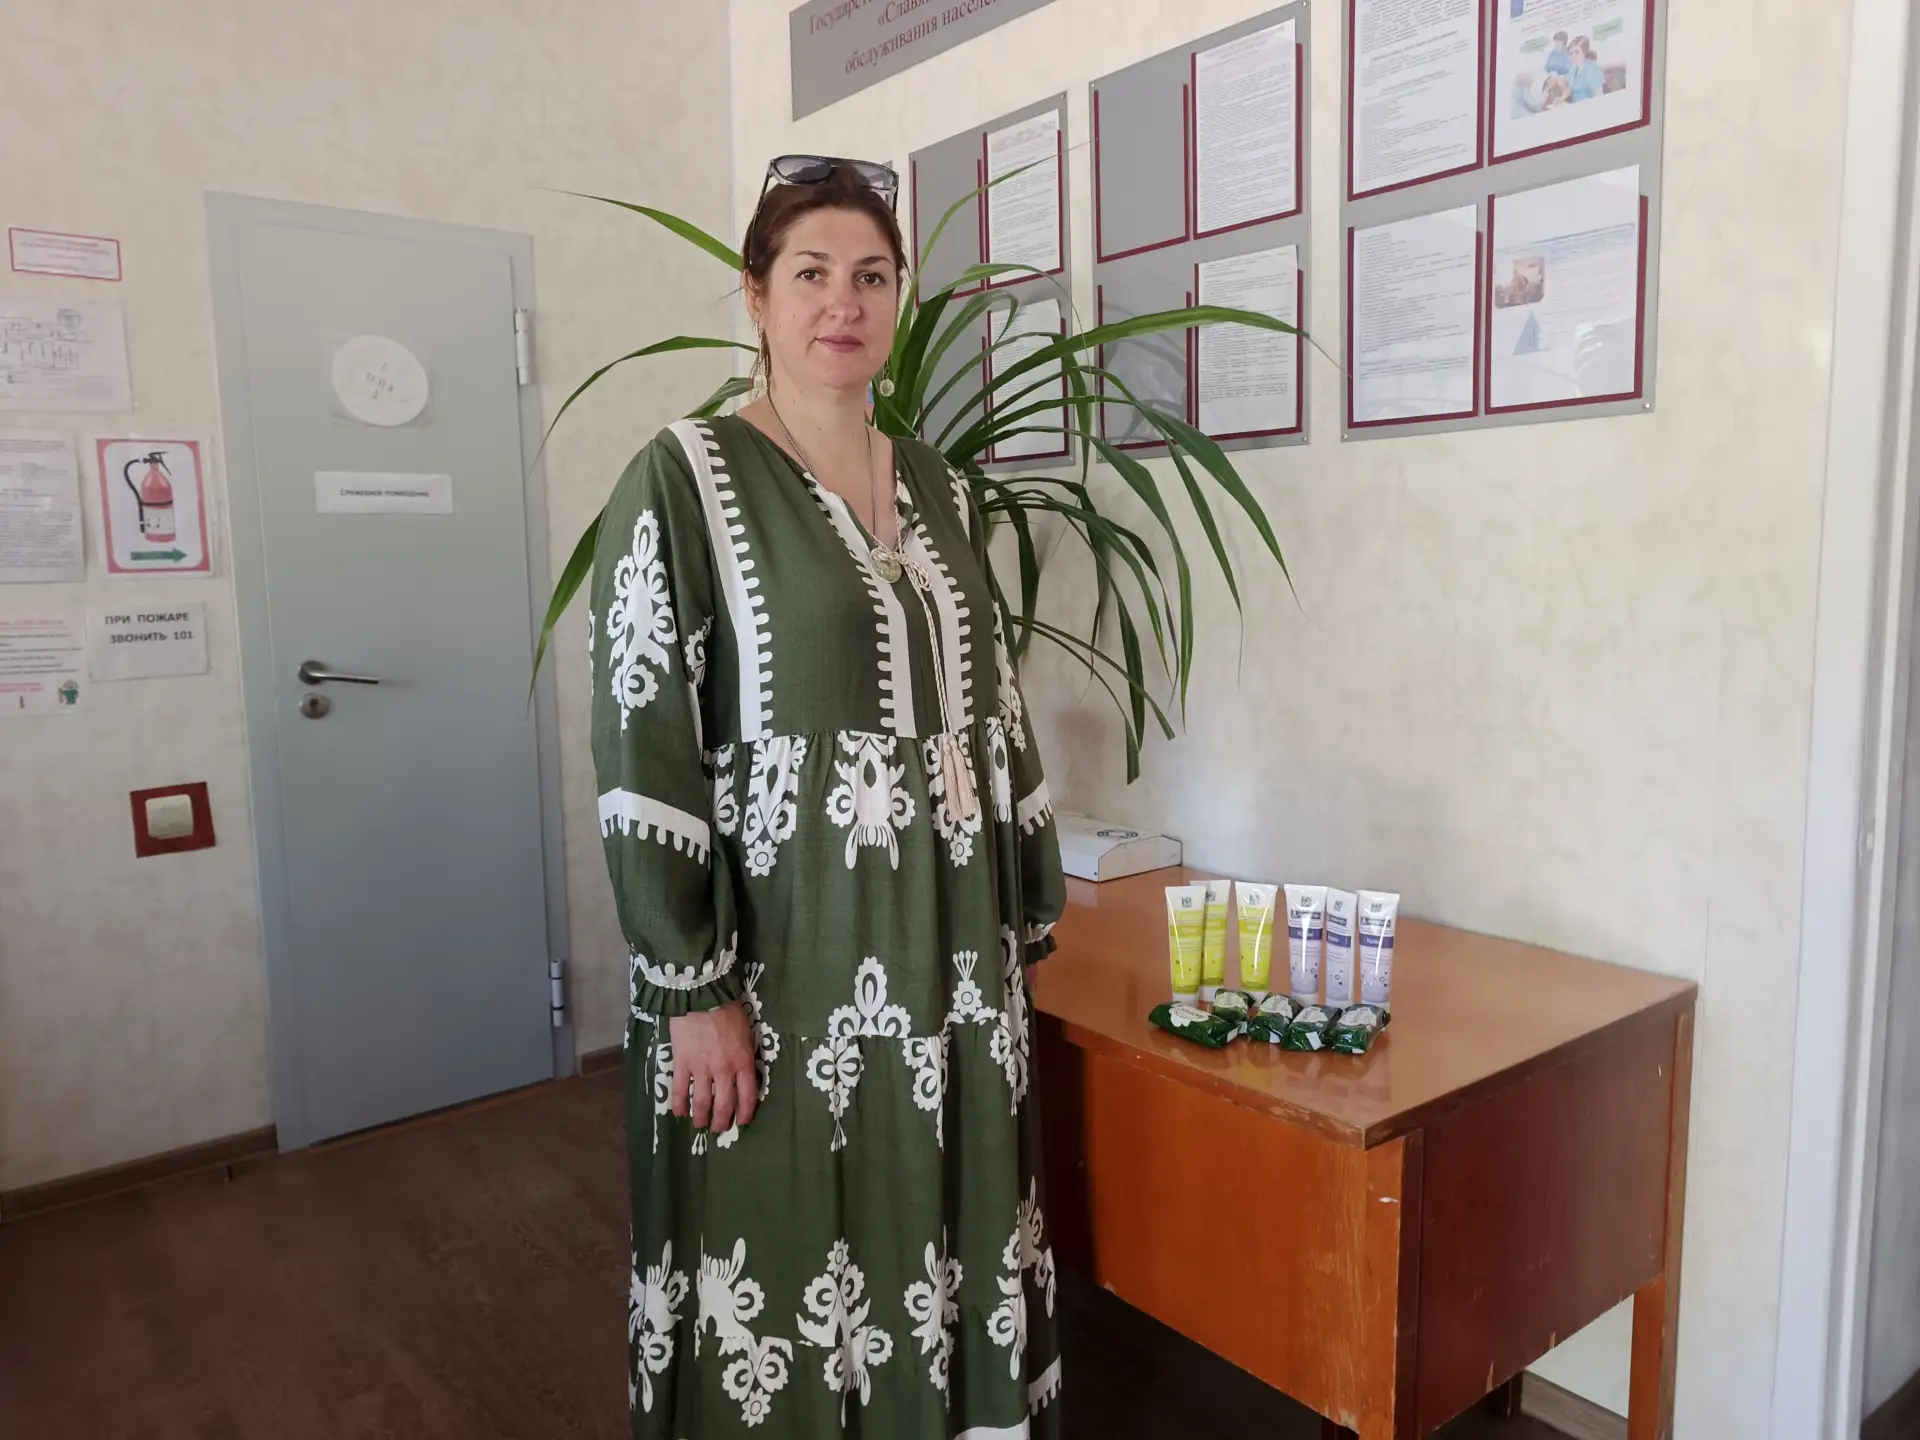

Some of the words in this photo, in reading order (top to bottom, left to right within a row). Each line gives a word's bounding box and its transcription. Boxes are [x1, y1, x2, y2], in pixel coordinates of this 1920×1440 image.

[844, 15, 938, 75] обслуживания
[105, 615, 131, 625] ПРИ
[137, 612, 189, 624] ПОЖАРЕ
[109, 632, 167, 644] ЗВОНИТЬ
[173, 630, 194, 641] 101
